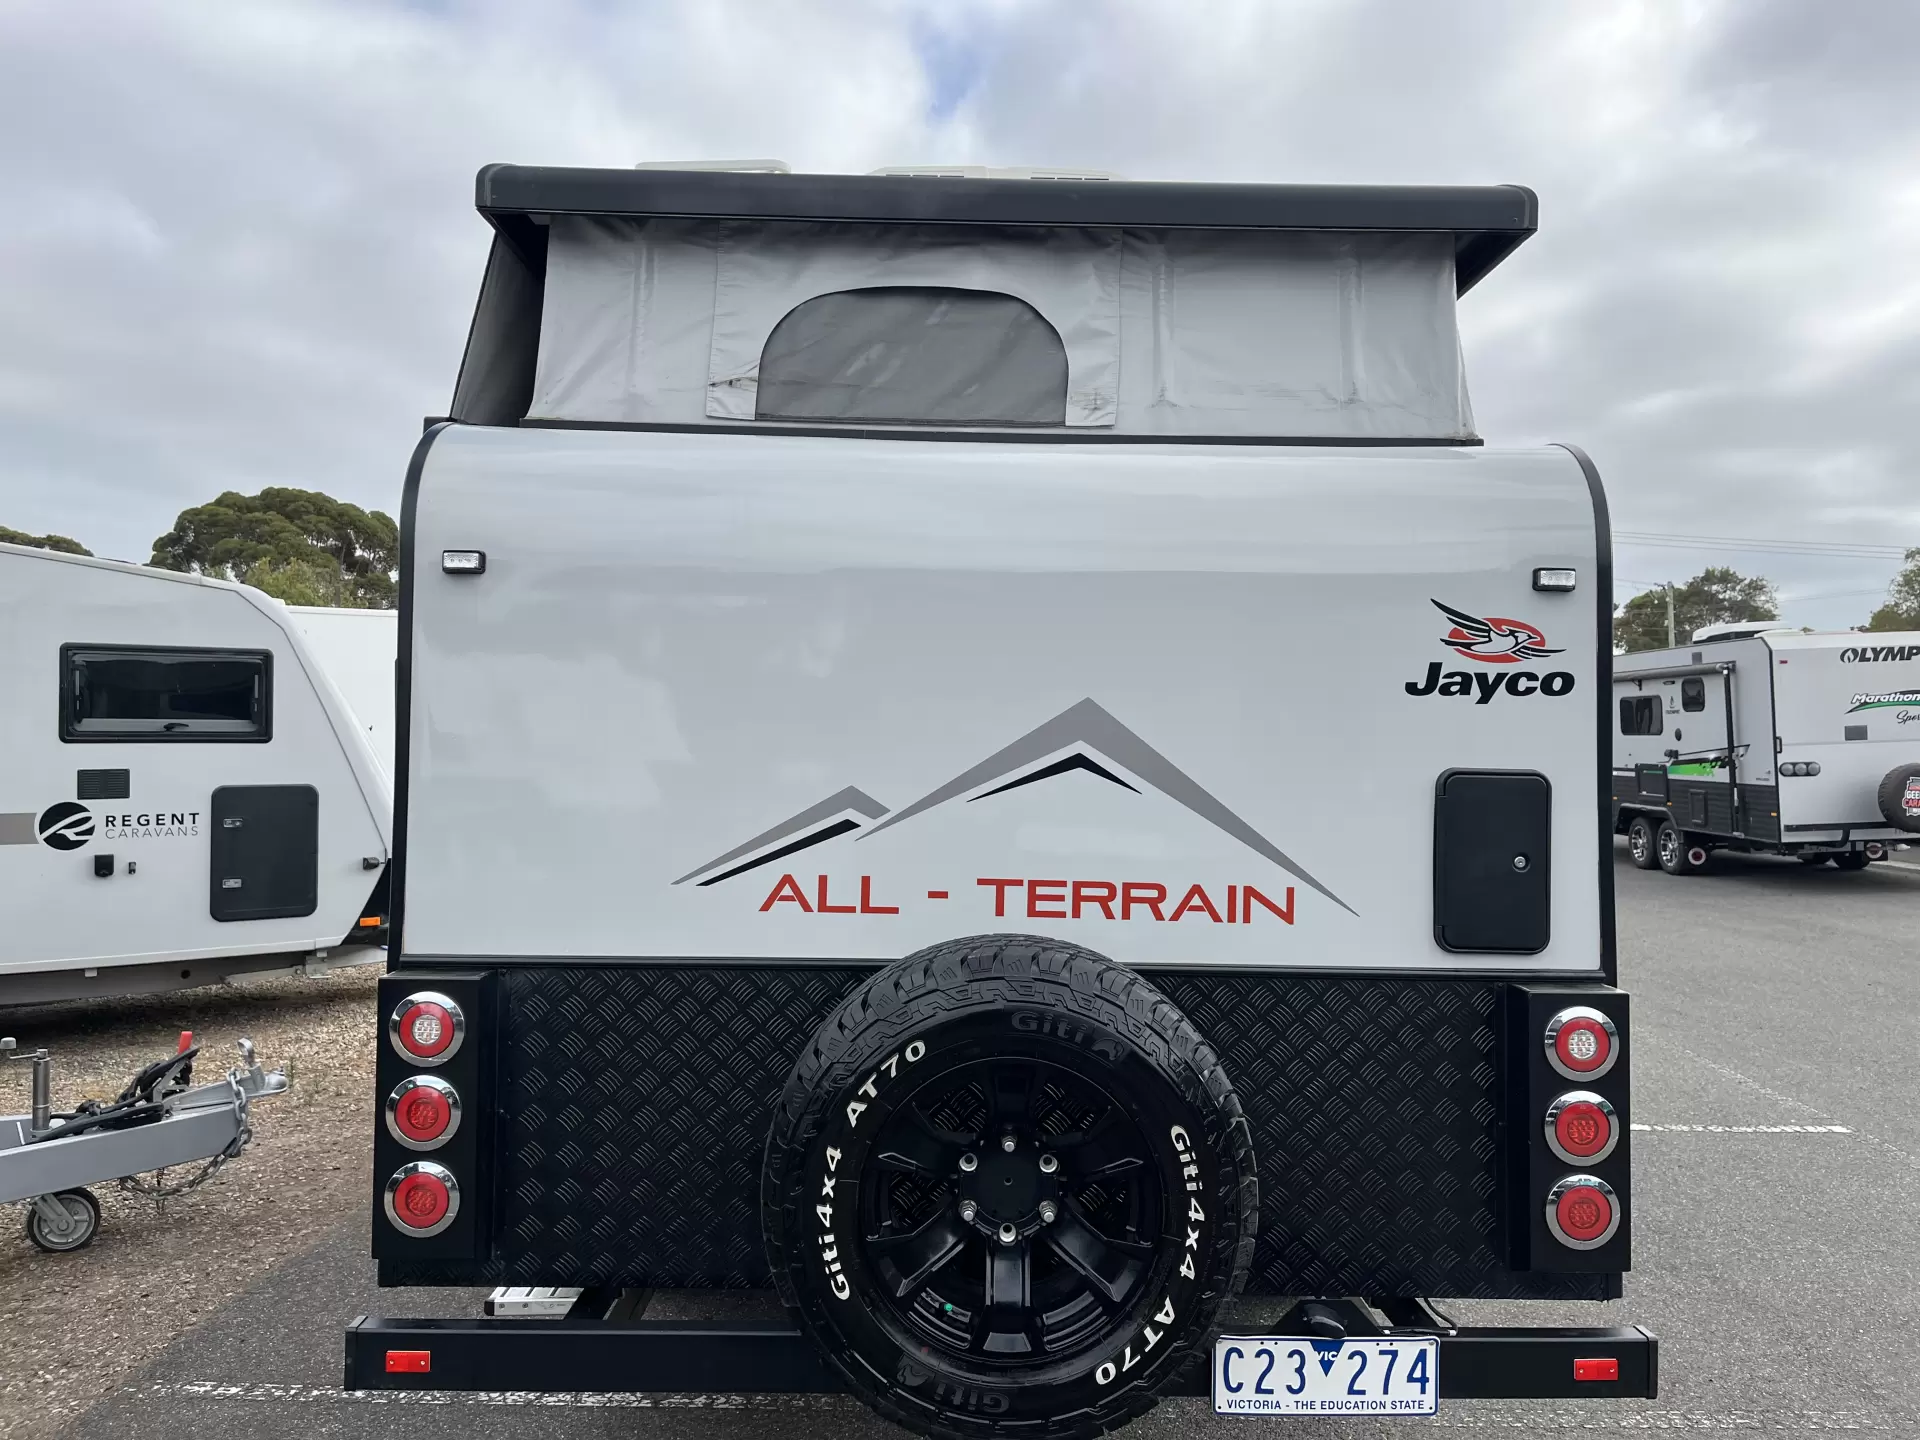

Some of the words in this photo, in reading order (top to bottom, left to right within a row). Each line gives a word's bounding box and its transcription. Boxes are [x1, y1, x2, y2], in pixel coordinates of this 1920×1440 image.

[1404, 662, 1575, 705] Jayco
[105, 812, 200, 828] REGENT
[105, 826, 199, 839] CARAVANS
[758, 874, 899, 914] ALL
[976, 877, 1295, 925] TERRAIN
[1011, 1010, 1088, 1044] Giti
[846, 1039, 926, 1128] AT70
[1095, 1294, 1176, 1386] AT70
[1314, 1350, 1339, 1361] VIC
[1223, 1346, 1306, 1395] C23
[1347, 1348, 1430, 1396] 274
[933, 1382, 1010, 1413] Giti
[1226, 1399, 1282, 1411] VICTORIA
[1293, 1400, 1317, 1411] THE
[1320, 1400, 1388, 1411] EDUCATION
[1390, 1400, 1425, 1411] STATE
